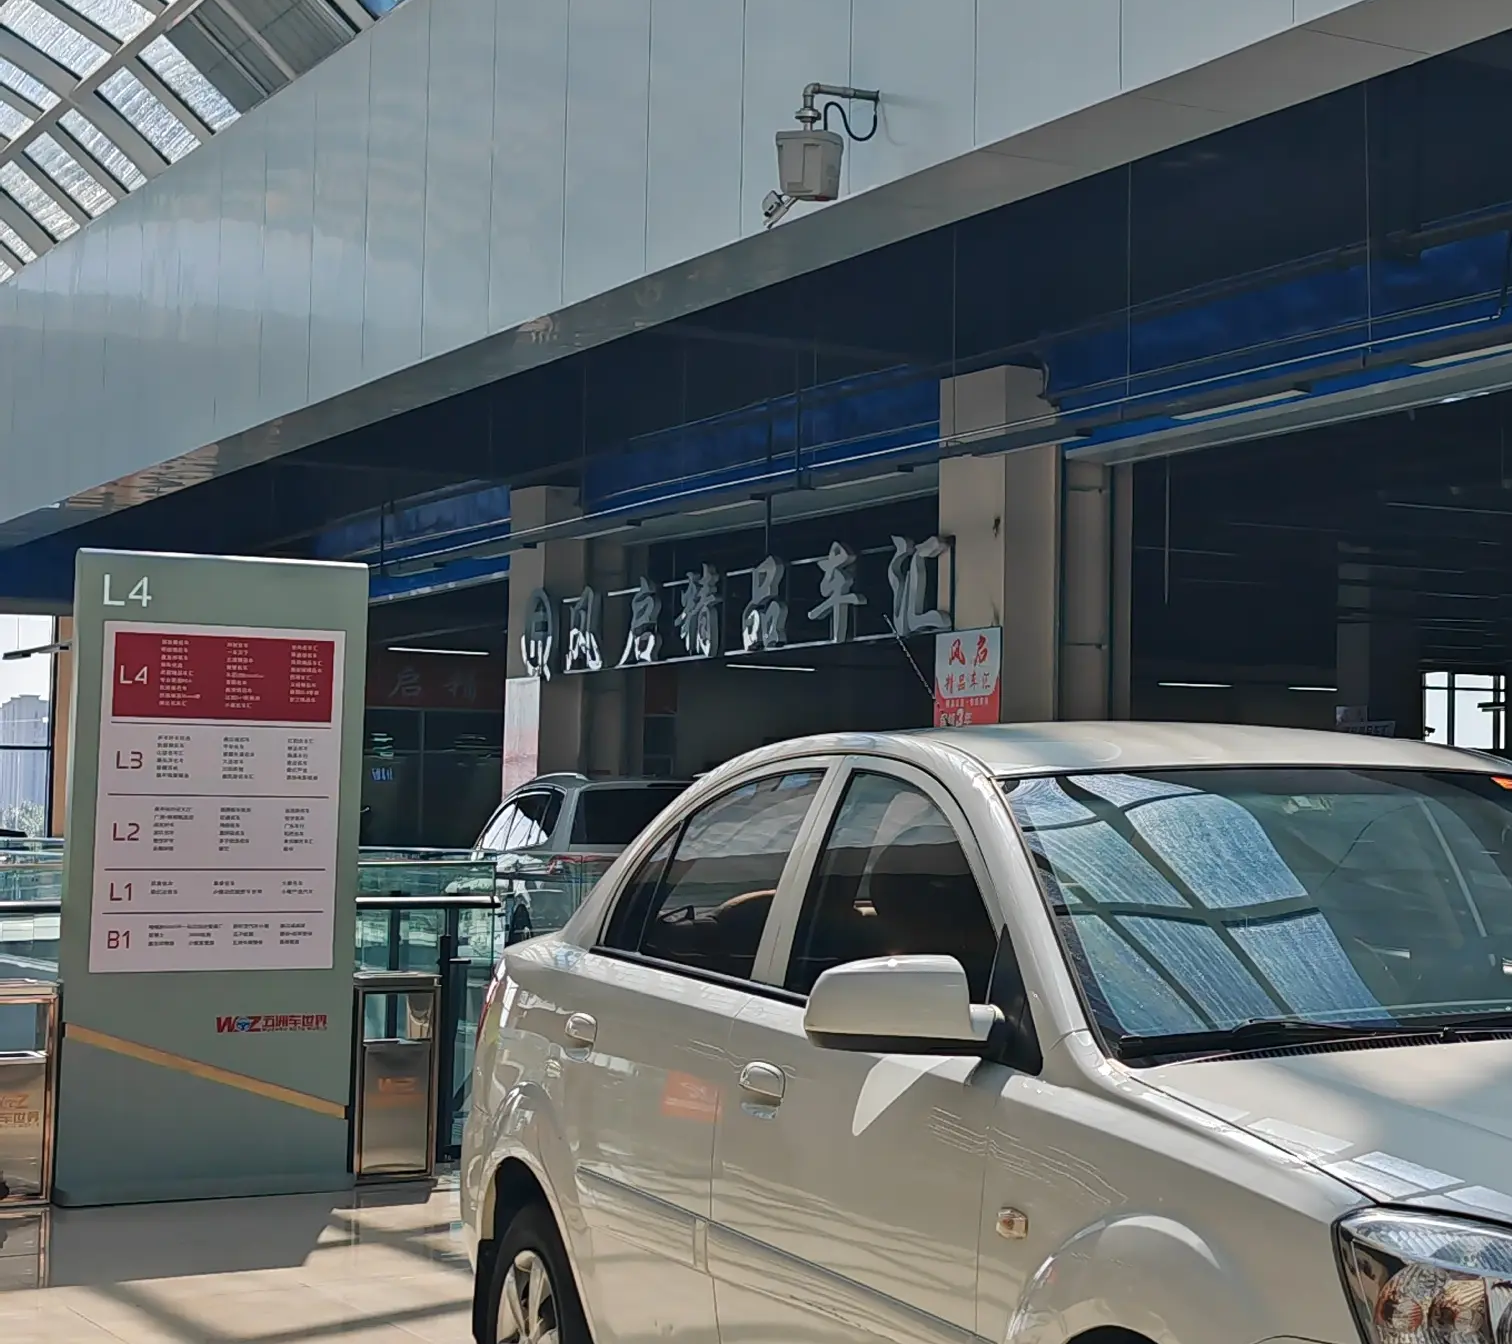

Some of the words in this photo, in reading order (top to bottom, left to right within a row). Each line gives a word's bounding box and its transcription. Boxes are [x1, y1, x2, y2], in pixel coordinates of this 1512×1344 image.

[103, 574, 152, 607] L4
[566, 535, 953, 671] 风启精品车汇
[119, 665, 148, 685] L4
[116, 751, 143, 770] L3
[112, 823, 140, 841] L2
[110, 883, 133, 901] L1
[107, 930, 130, 949] B1
